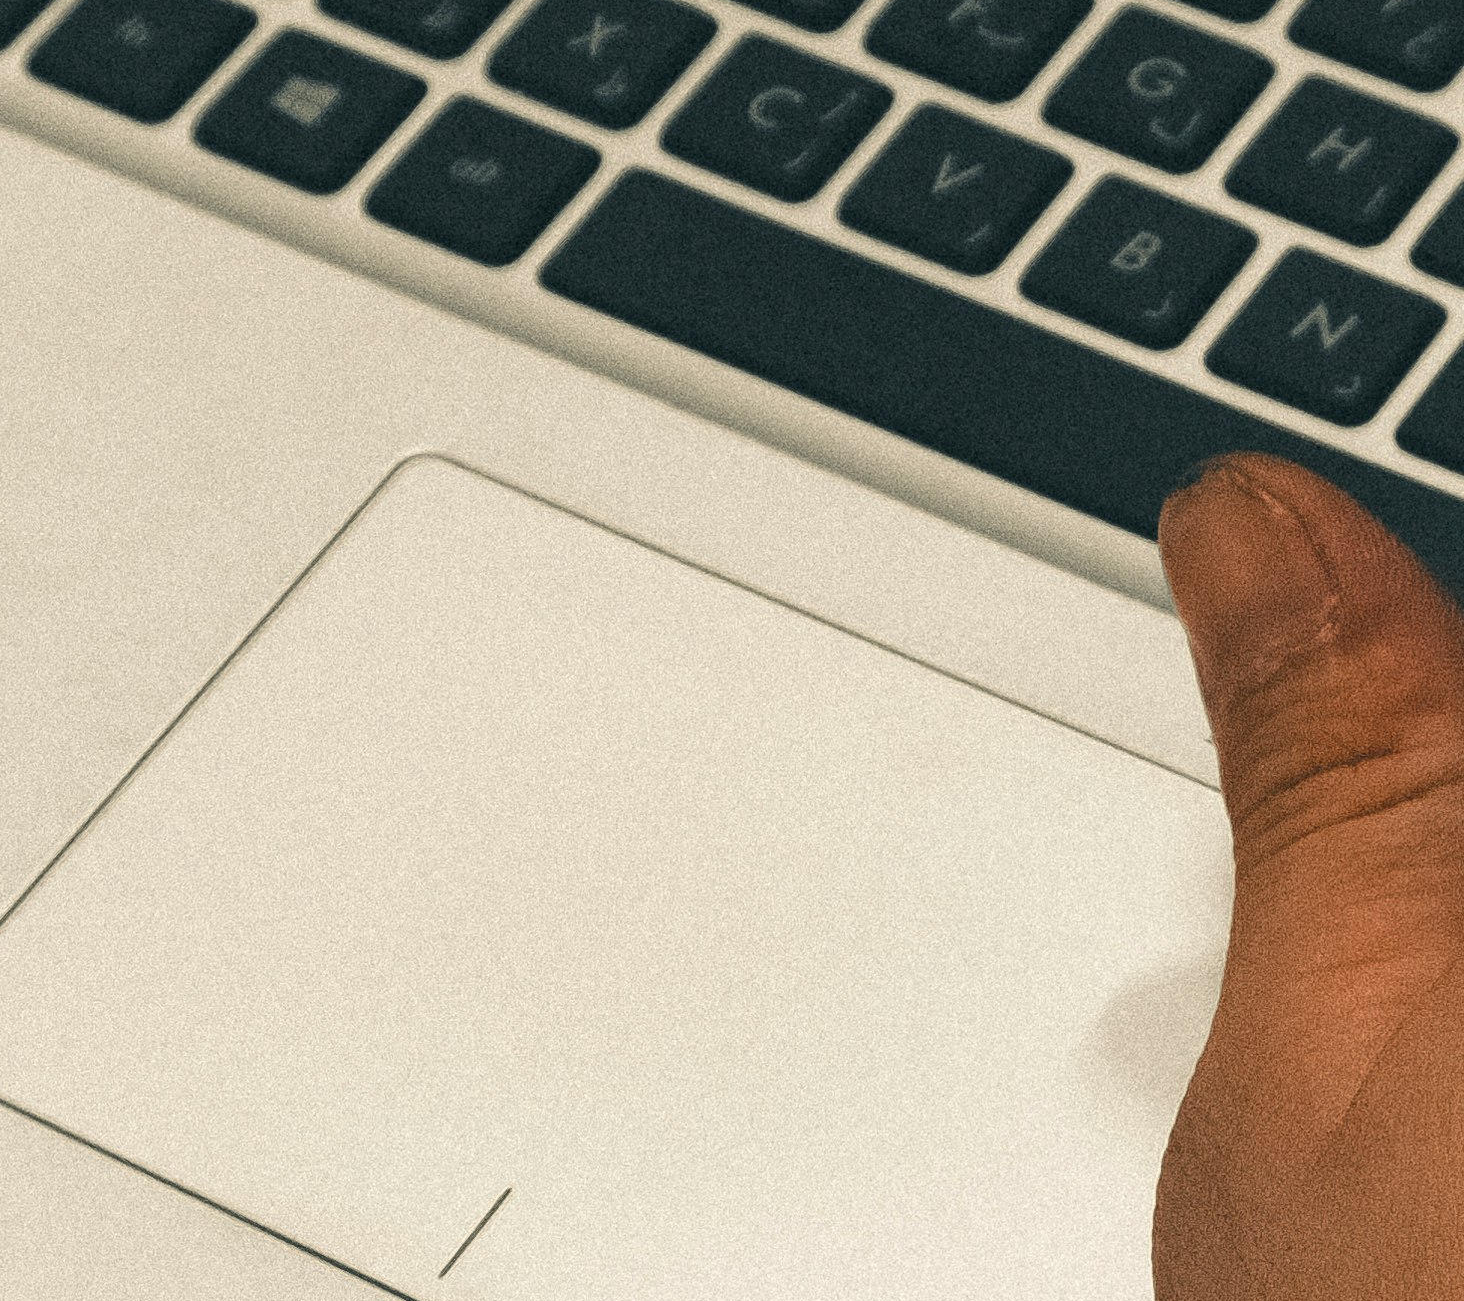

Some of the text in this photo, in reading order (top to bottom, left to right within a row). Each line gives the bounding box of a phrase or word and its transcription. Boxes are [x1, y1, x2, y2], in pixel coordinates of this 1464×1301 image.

[566, 8, 632, 58] X
[1128, 59, 1185, 98] G
[748, 87, 802, 128] C
[1310, 128, 1369, 170] H
[933, 156, 980, 192] V
[1112, 232, 1161, 270] B
[1292, 304, 1357, 349] N
